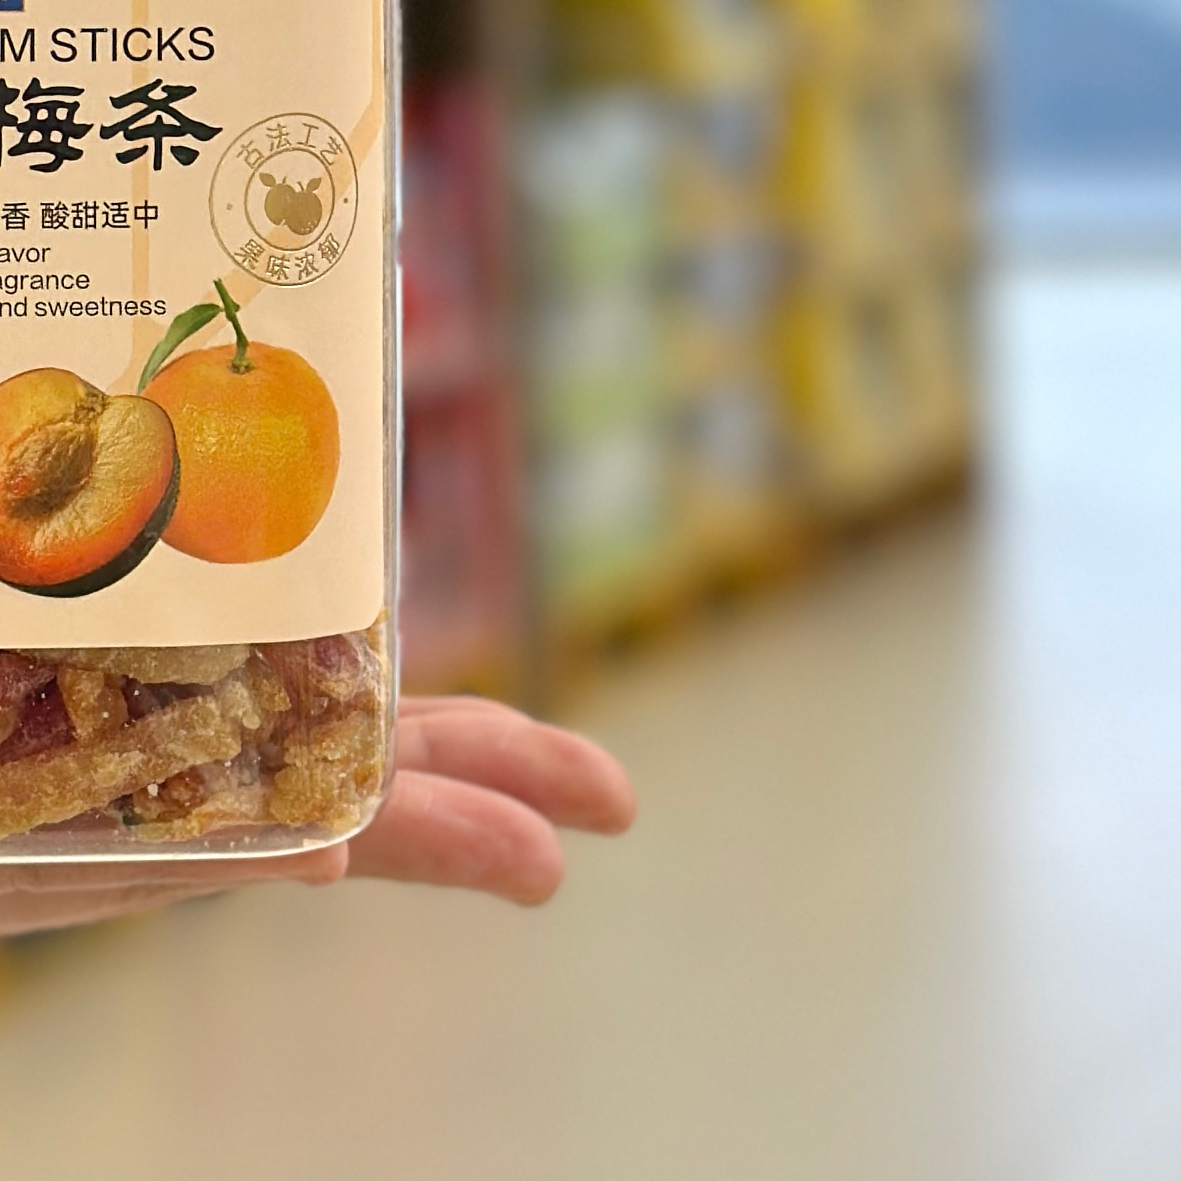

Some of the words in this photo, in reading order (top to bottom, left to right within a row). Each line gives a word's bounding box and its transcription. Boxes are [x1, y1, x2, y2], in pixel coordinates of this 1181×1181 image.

[50, 26, 215, 63] STICKS
[236, 122, 343, 170] 古法工艺
[39, 199, 159, 230] 酸甜适中
[234, 232, 341, 281] 果味浓郁
[34, 297, 167, 318] sweetness
